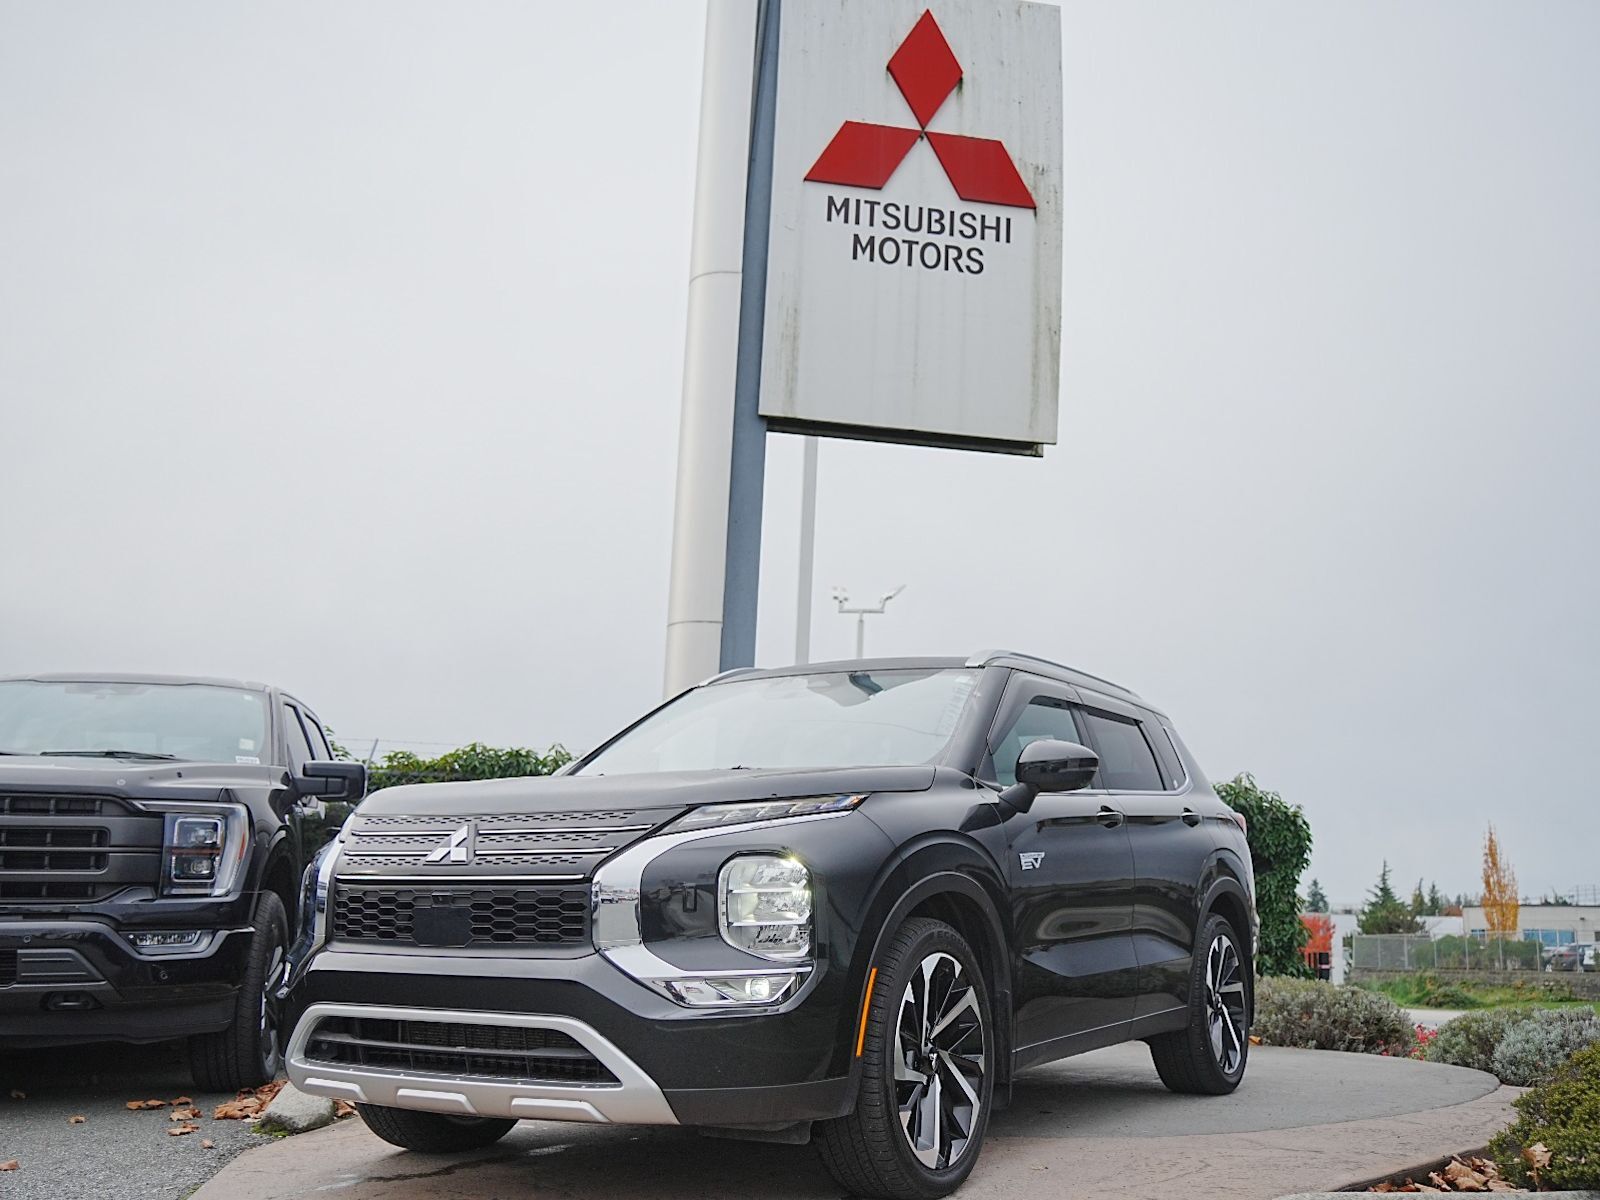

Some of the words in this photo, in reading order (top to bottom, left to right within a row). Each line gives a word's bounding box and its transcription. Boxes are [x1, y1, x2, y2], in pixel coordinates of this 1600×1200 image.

[826, 195, 1012, 244] MITSUBISHI
[852, 233, 984, 275] MOTORS
[1020, 857, 1042, 871] EV
